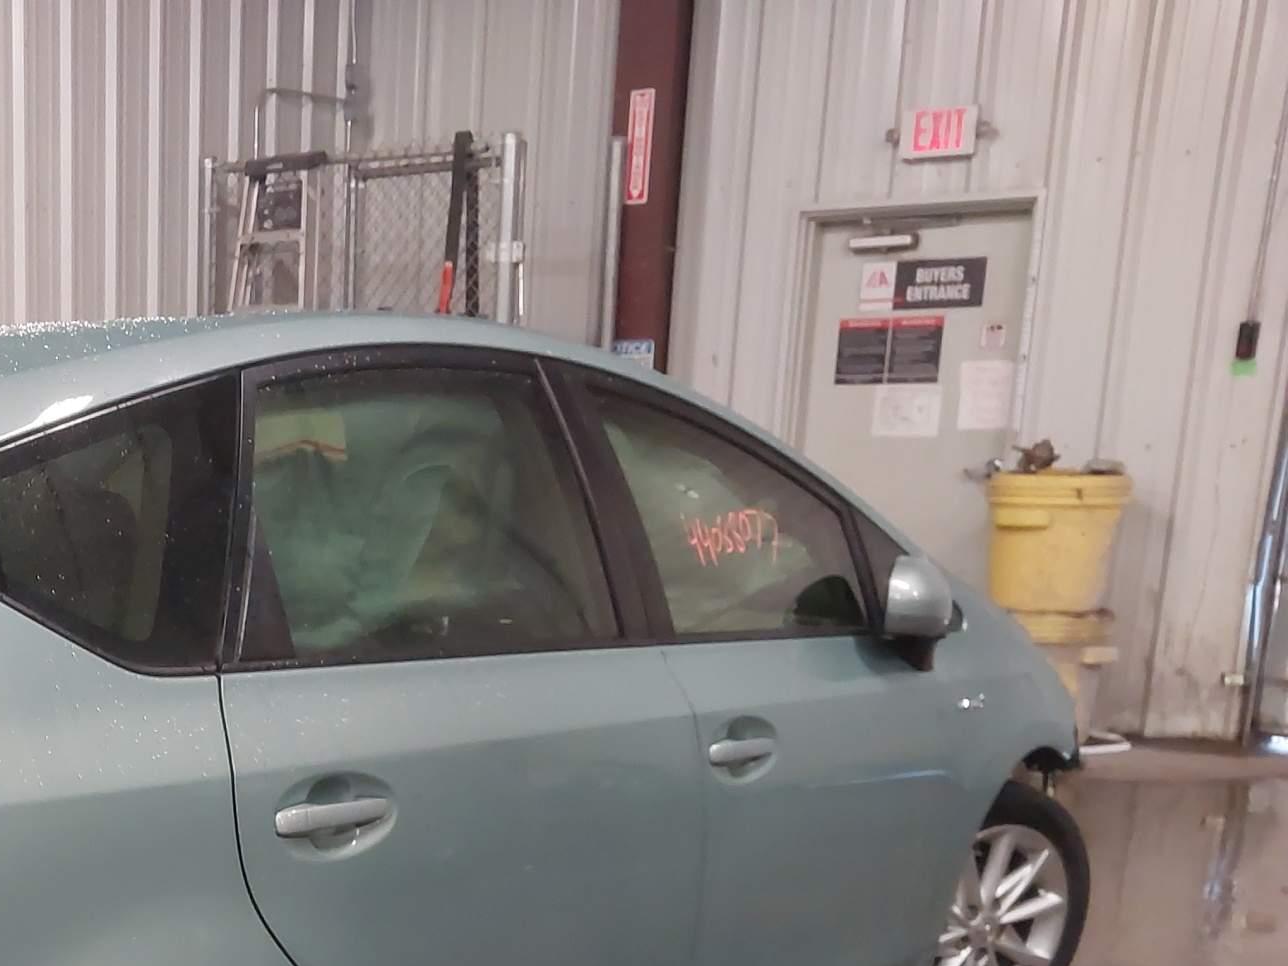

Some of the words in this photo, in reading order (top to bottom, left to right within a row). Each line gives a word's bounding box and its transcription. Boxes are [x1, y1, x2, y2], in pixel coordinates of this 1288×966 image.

[912, 108, 967, 152] EXIT
[915, 265, 966, 284] BUYERS
[905, 283, 971, 303] ENTRANCE
